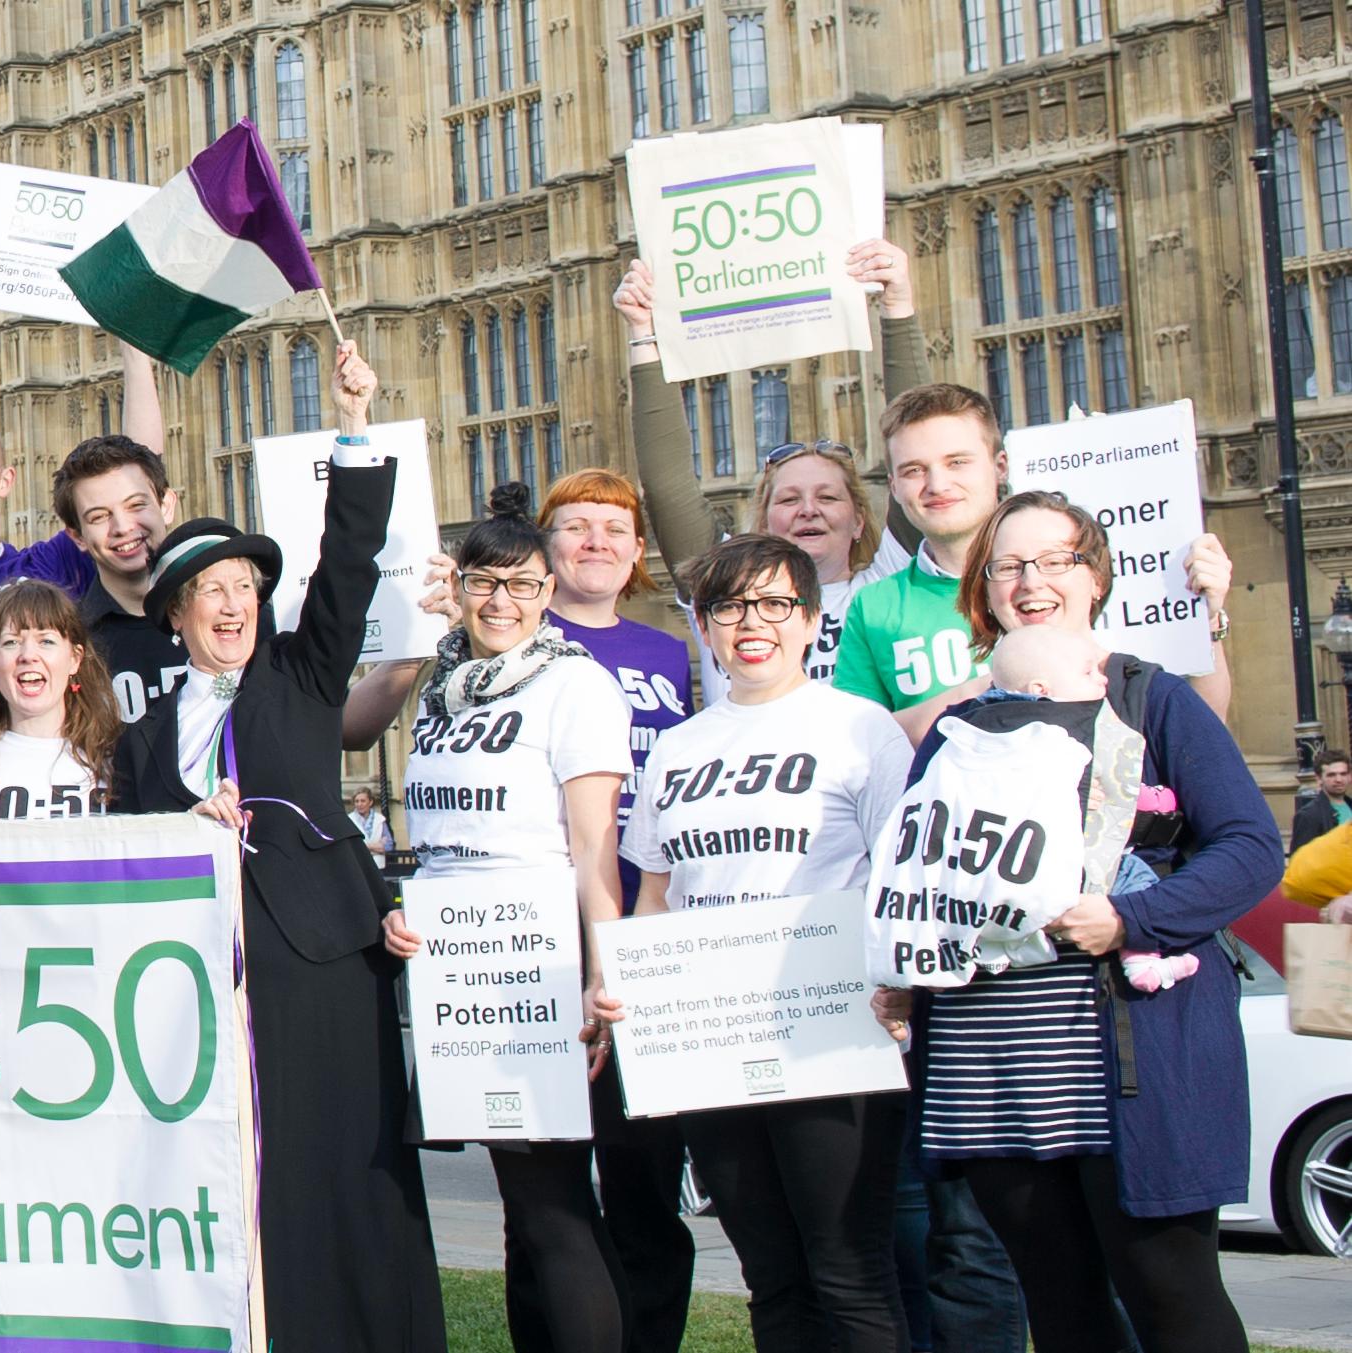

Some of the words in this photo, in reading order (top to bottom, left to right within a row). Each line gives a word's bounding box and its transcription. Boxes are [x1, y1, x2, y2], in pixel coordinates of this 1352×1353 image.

[15, 190, 83, 221] 50:50
[672, 187, 822, 257] 50:50
[675, 251, 825, 298] Parliament
[1026, 438, 1180, 475] #5050Parliament
[1097, 499, 1169, 528] oner
[1123, 597, 1201, 627] Later
[656, 753, 817, 810] 50:50
[661, 827, 810, 865] arliament
[895, 800, 1046, 885] 50:50
[440, 906, 486, 927] Only
[494, 902, 538, 921] 23%
[427, 939, 503, 956] Women
[511, 934, 556, 952] MPs
[616, 947, 648, 963] Sign
[653, 940, 694, 957] 50:50
[698, 930, 778, 951] Parliament
[782, 922, 838, 940] Petition
[445, 973, 457, 982] =
[464, 965, 541, 986] unused
[620, 961, 682, 981] because
[677, 998, 710, 1013] from
[714, 994, 737, 1009] the
[742, 986, 800, 1004] obvious
[803, 979, 865, 1004] injustice
[437, 998, 557, 1026] Potential
[631, 1026, 652, 1038] we
[657, 1022, 681, 1035] are
[685, 1018, 698, 1031] in
[703, 1016, 721, 1029] no
[726, 1009, 784, 1031] position
[788, 1006, 802, 1019] to
[806, 1000, 849, 1017] under
[431, 1038, 569, 1057] #5050Parliament
[635, 1039, 677, 1057] utilise
[682, 1037, 698, 1051] so
[704, 1030, 745, 1047] much
